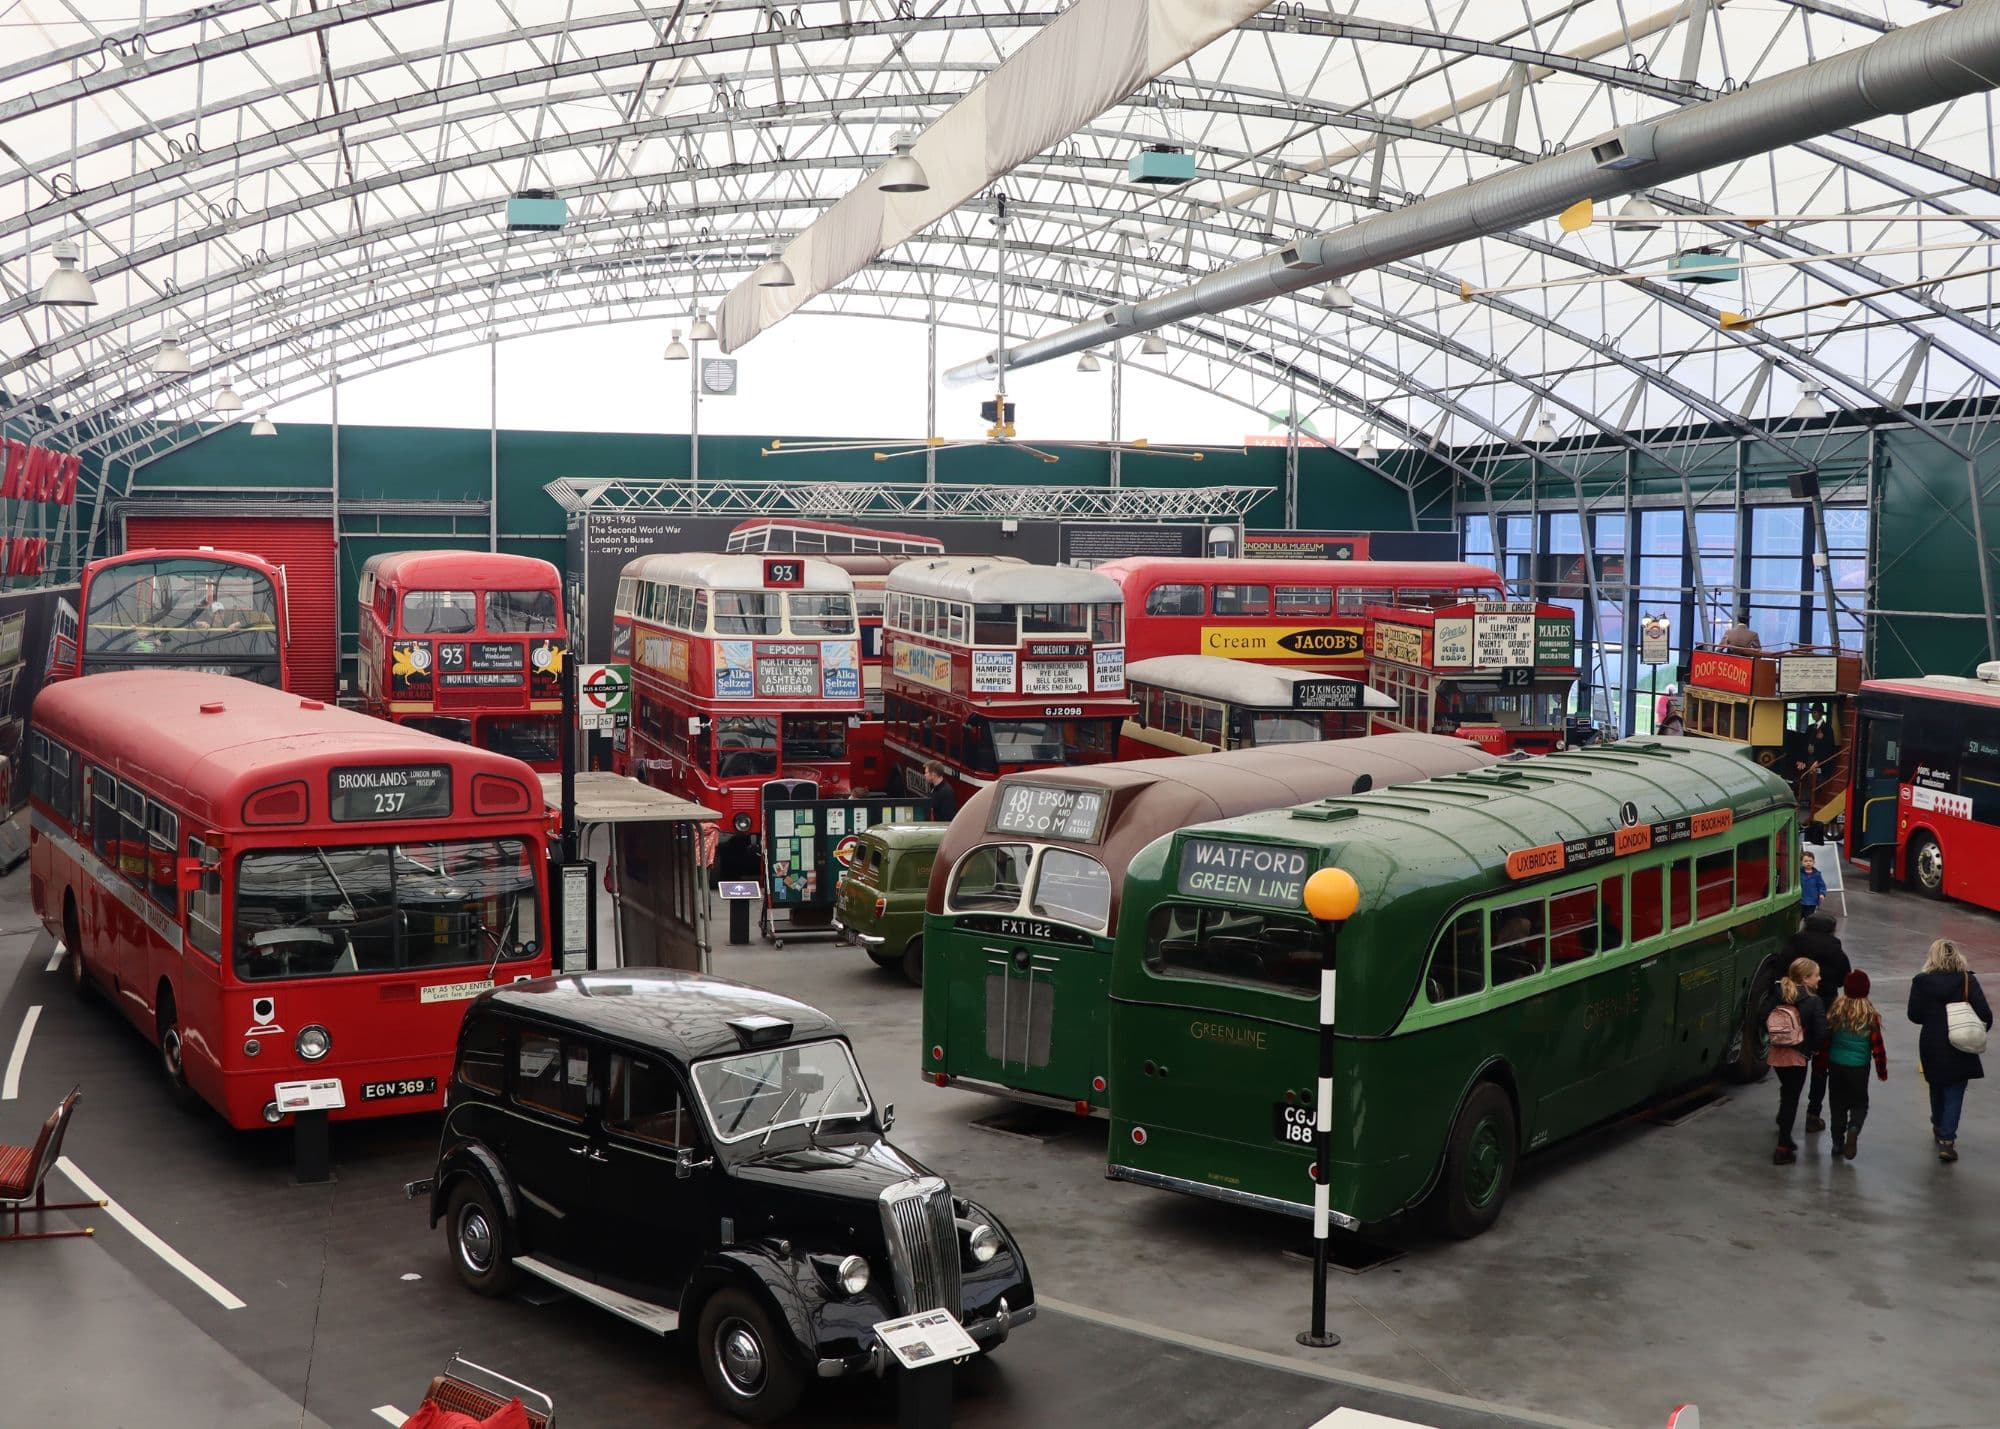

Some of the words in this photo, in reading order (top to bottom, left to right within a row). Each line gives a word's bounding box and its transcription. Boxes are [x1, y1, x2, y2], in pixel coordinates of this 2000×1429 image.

[590, 516, 636, 524] 1939-1945
[590, 526, 606, 534] The
[608, 526, 637, 534] Second
[638, 526, 664, 534] World
[664, 526, 681, 534] War
[590, 536, 628, 544] London's
[630, 536, 654, 544] Buses
[602, 546, 622, 555] carry
[624, 546, 638, 554] on!
[1289, 543, 1324, 552] MUSEUM
[773, 565, 792, 581] 93
[1484, 603, 1507, 612] OXFORD
[1511, 603, 1532, 612] CIRCUS
[1478, 616, 1488, 624] RYE
[1506, 616, 1531, 624] PECKHAM
[1490, 624, 1518, 632] ELEPHANT
[1539, 625, 1571, 638] MAPLES
[1479, 632, 1516, 640] WESTMINSTER
[1209, 633, 1266, 649] Cream
[1294, 635, 1358, 649] JACOB'S
[769, 646, 805, 654] EPSOM
[1032, 645, 1070, 654] SHOREDITCH
[442, 648, 463, 665] 93
[976, 653, 1013, 664] GRAPHIC
[1096, 652, 1122, 664] GRAPHIC
[760, 658, 786, 666] NORTH
[787, 658, 812, 666] CHEAM
[760, 668, 783, 676] EWELL
[788, 668, 813, 676] EPSOM
[975, 666, 1012, 674] HAMPERS
[1096, 666, 1108, 674] AIR
[1108, 665, 1123, 673] DARE
[1694, 660, 1718, 678] DOOF
[1718, 662, 1748, 686] SEGDIR
[474, 674, 499, 683] CHEAM
[729, 670, 750, 679] Alka
[836, 670, 856, 679] Alka
[1100, 675, 1121, 683] DEVILS
[1508, 669, 1529, 686] 12
[718, 678, 751, 688] Seltzer
[766, 676, 808, 684] ASHTEAD
[825, 679, 856, 688] Seltzer
[975, 677, 1012, 685] HAMPERS
[762, 685, 812, 694] LEATHERHEAD
[1300, 685, 1316, 698] 213
[1316, 684, 1357, 694] KINGSTON
[584, 718, 596, 726] 237
[600, 717, 613, 725] 267
[338, 772, 408, 789] BROOKLANDS
[410, 770, 430, 778] LONDON
[431, 770, 442, 778] BUS
[416, 778, 436, 786] MUSEUM
[374, 792, 406, 813] 237
[1009, 789, 1034, 814] 481
[1038, 791, 1074, 808] EPSOM
[1076, 795, 1100, 812] STN
[1057, 809, 1071, 817] AND
[1625, 804, 1635, 823] L
[1003, 812, 1066, 832] EPSOM
[1619, 831, 1648, 850] LONDON
[1196, 844, 1305, 875] WATFORD
[1516, 850, 1557, 872] UXBRIDGE
[1189, 871, 1252, 894] GREEN
[1258, 878, 1300, 901] LINE
[451, 984, 467, 992] YOU
[469, 981, 492, 990] ENTER
[1190, 1021, 1234, 1040] GREEN
[1237, 1027, 1267, 1050] LINE
[366, 1083, 396, 1098] EGN
[1284, 1106, 1317, 1126] CGJ
[1286, 1124, 1312, 1144] 188
